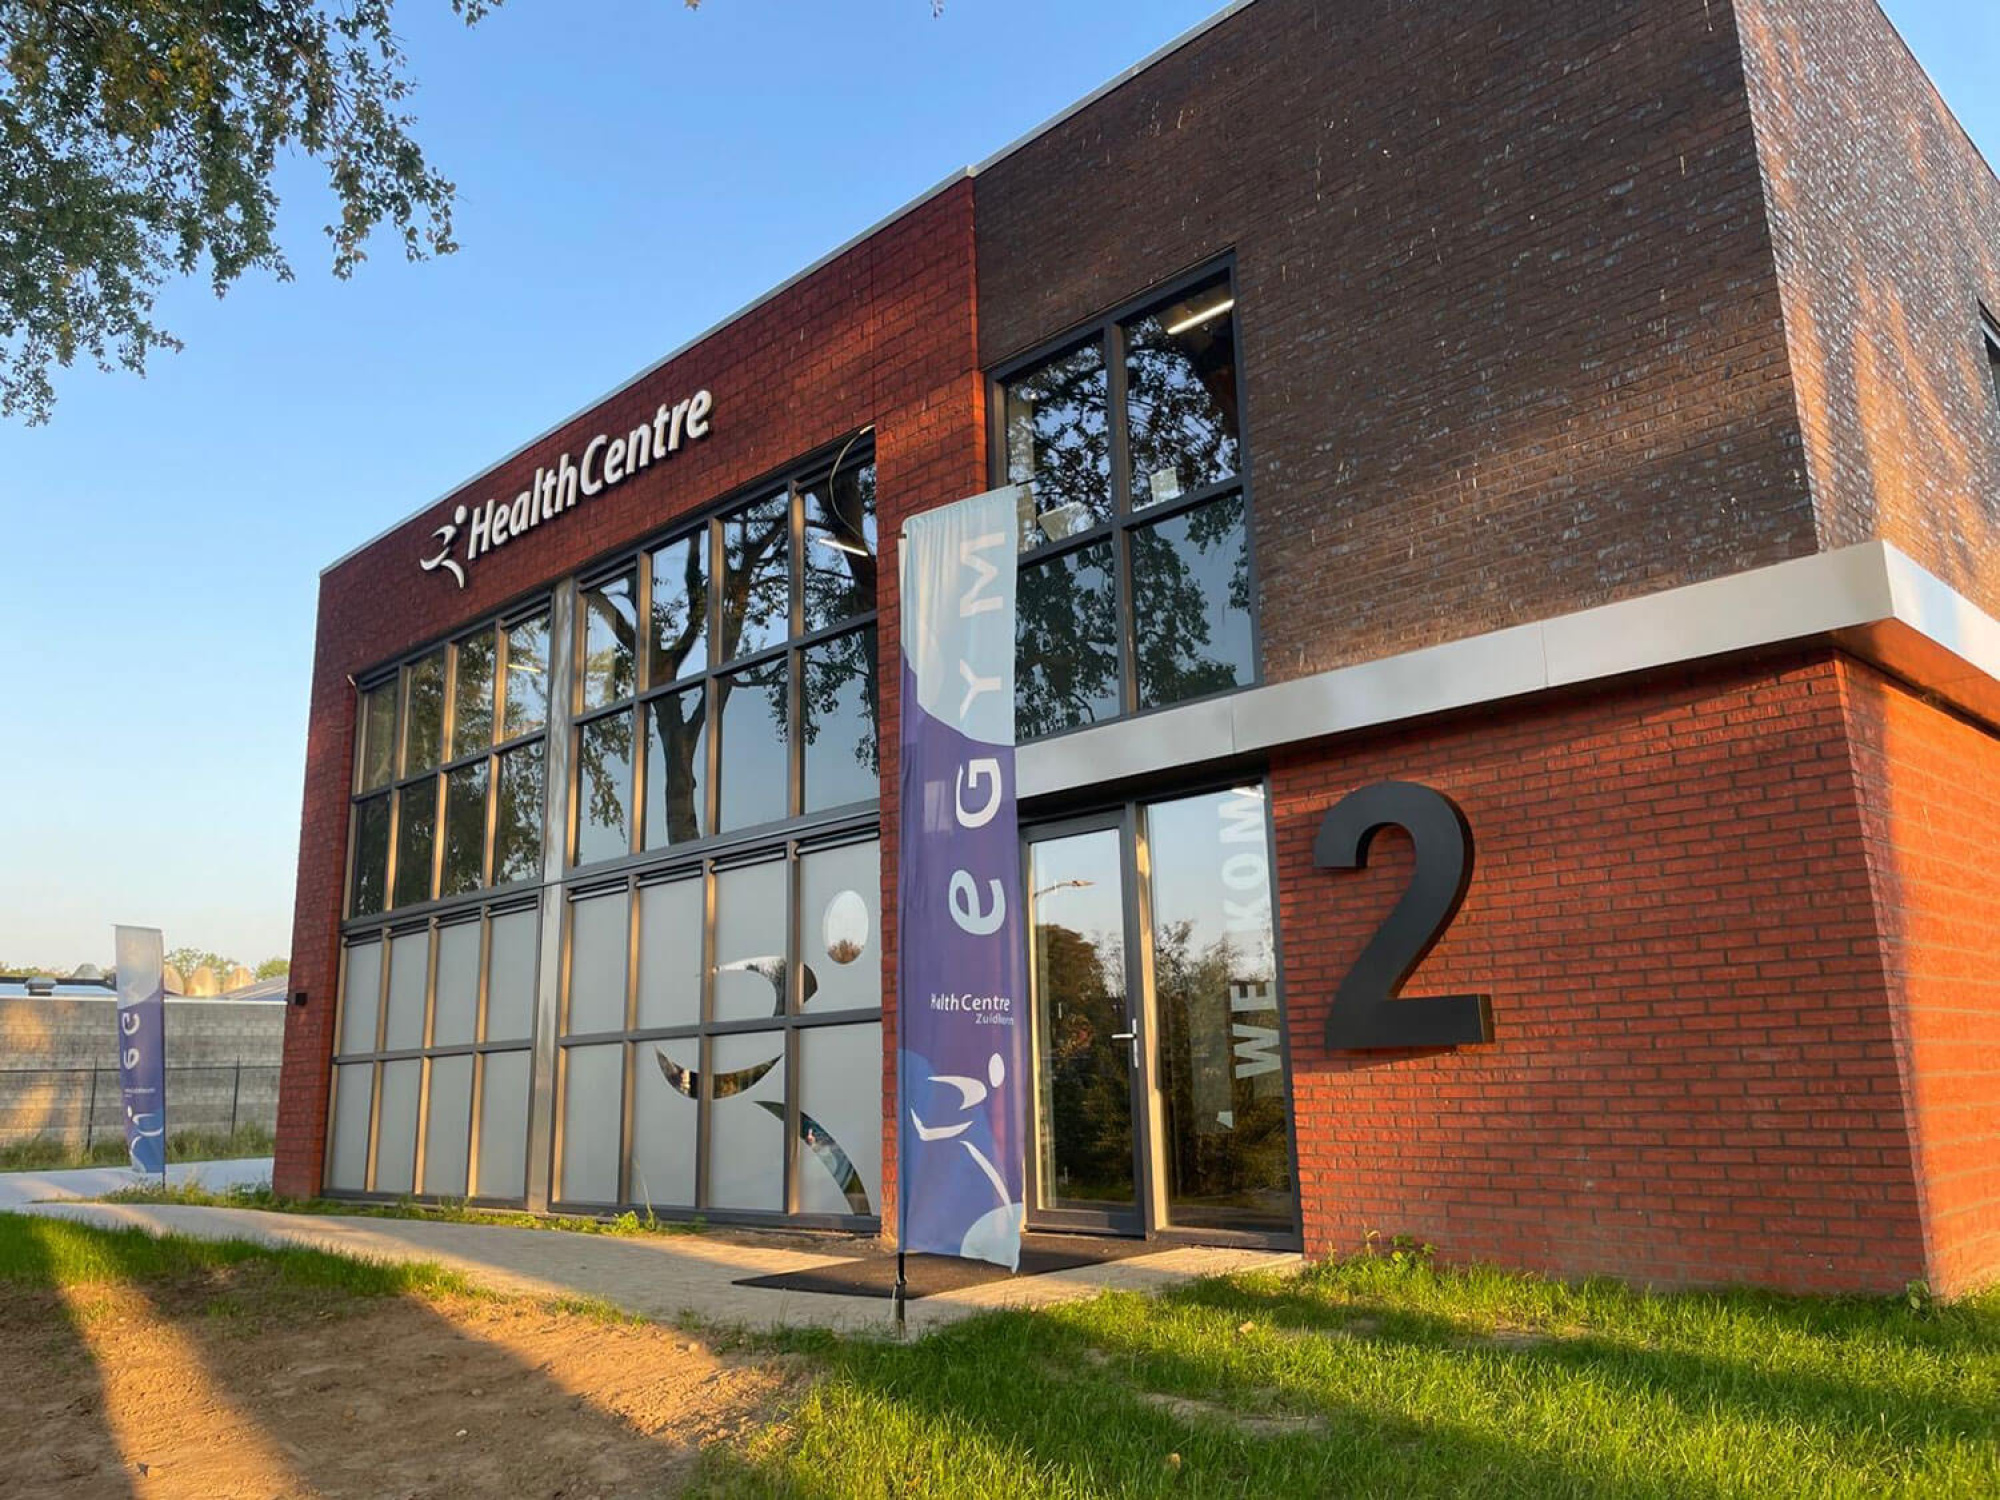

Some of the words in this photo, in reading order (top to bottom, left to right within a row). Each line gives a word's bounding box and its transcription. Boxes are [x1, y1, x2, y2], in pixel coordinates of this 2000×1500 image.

[467, 390, 713, 560] HealthCentre
[1218, 798, 1282, 1080] WEKOM
[1312, 781, 1494, 1050] 2
